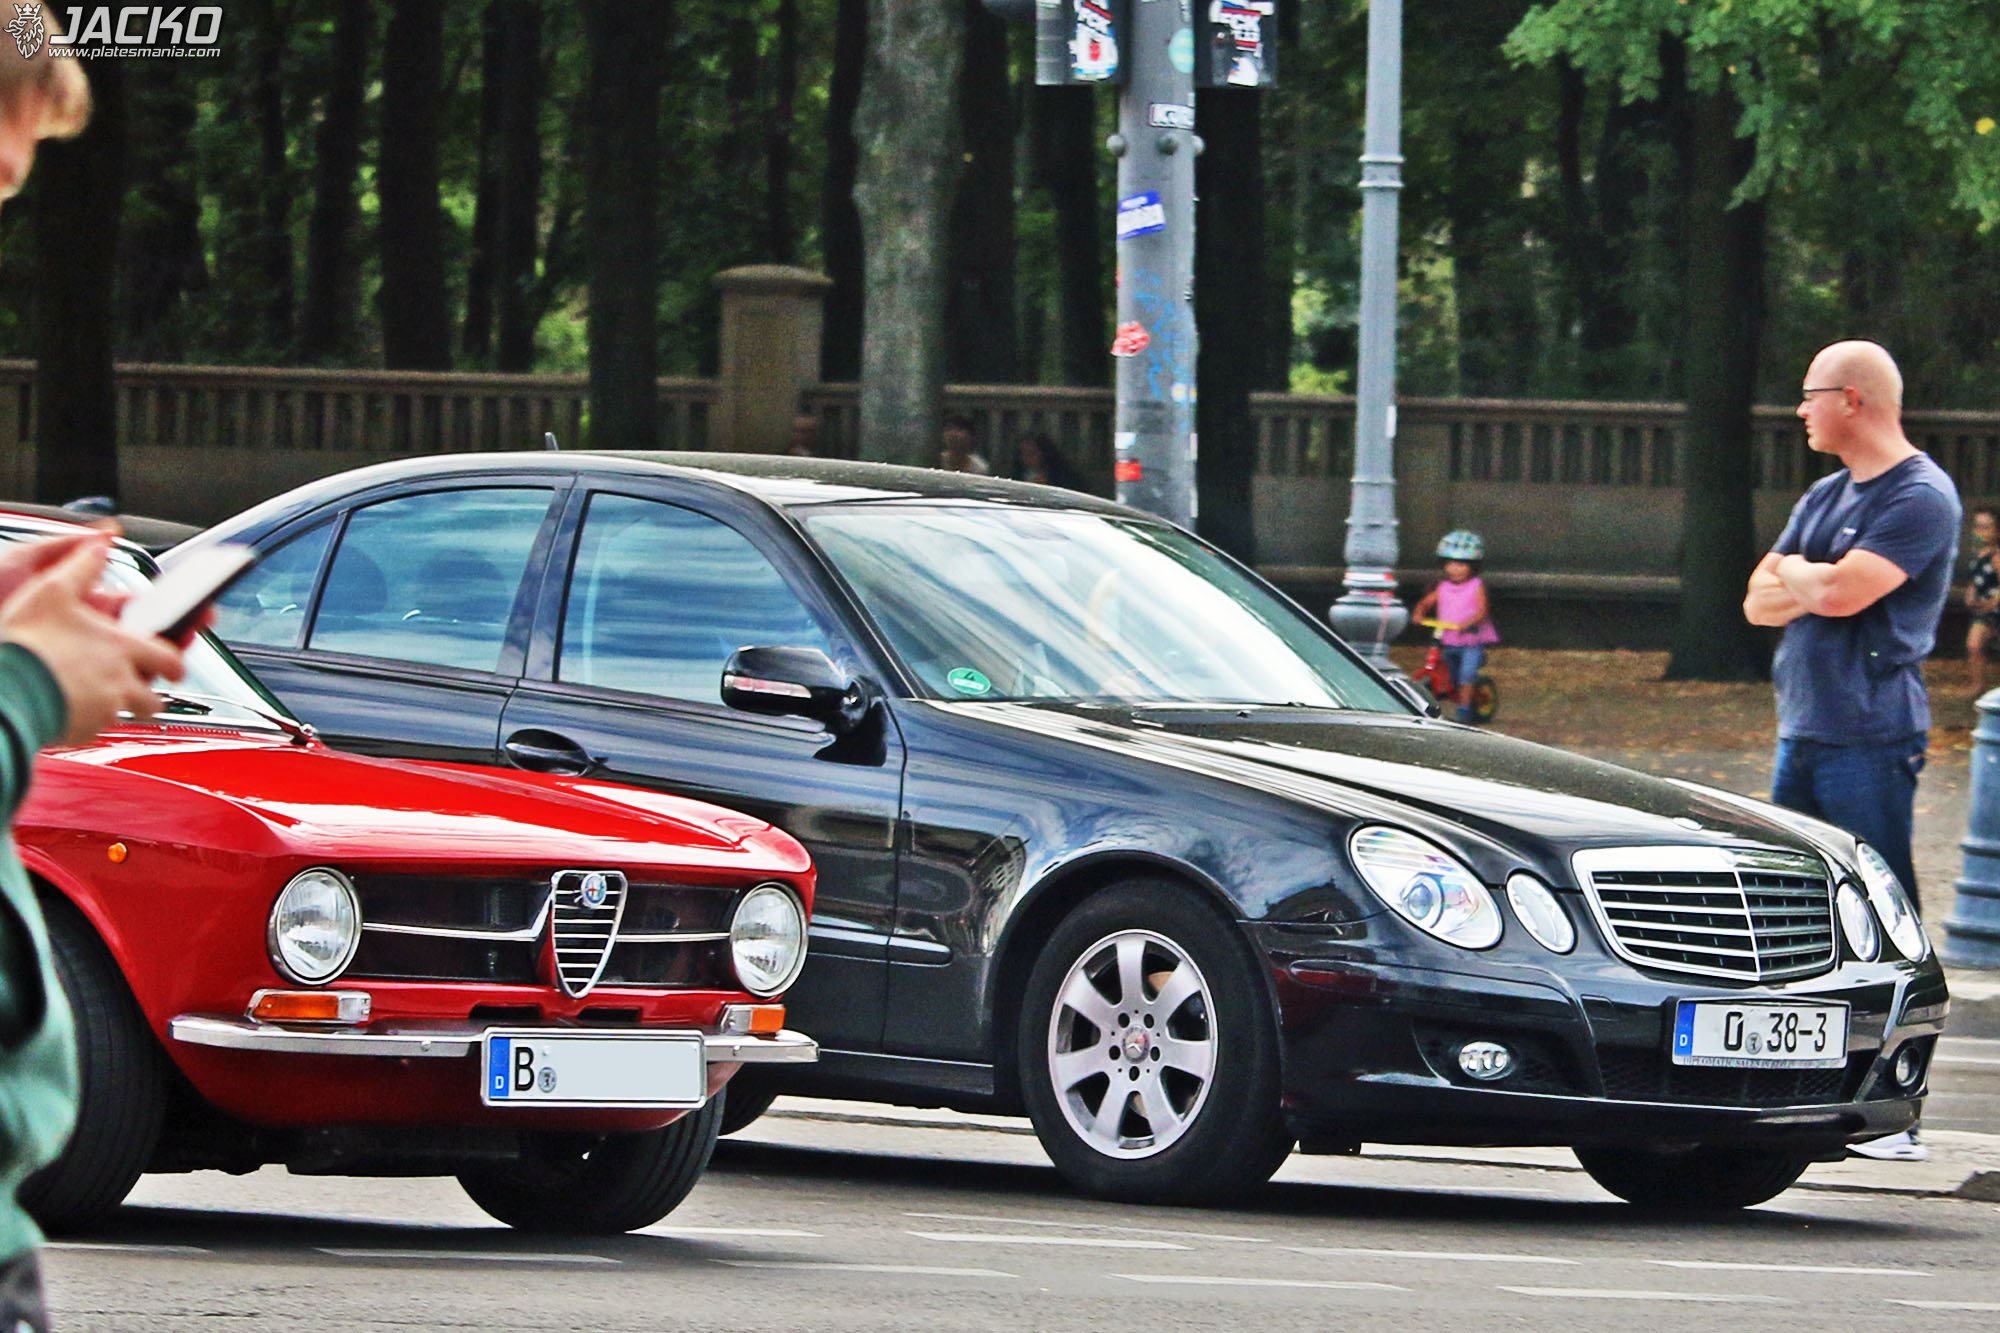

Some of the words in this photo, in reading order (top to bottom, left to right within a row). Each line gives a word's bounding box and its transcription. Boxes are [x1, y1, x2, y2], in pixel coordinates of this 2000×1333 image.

[1679, 1034, 1688, 1047] D
[1767, 1012, 1828, 1052] 38-3
[514, 1046, 536, 1091] B
[494, 1075, 505, 1090] D
